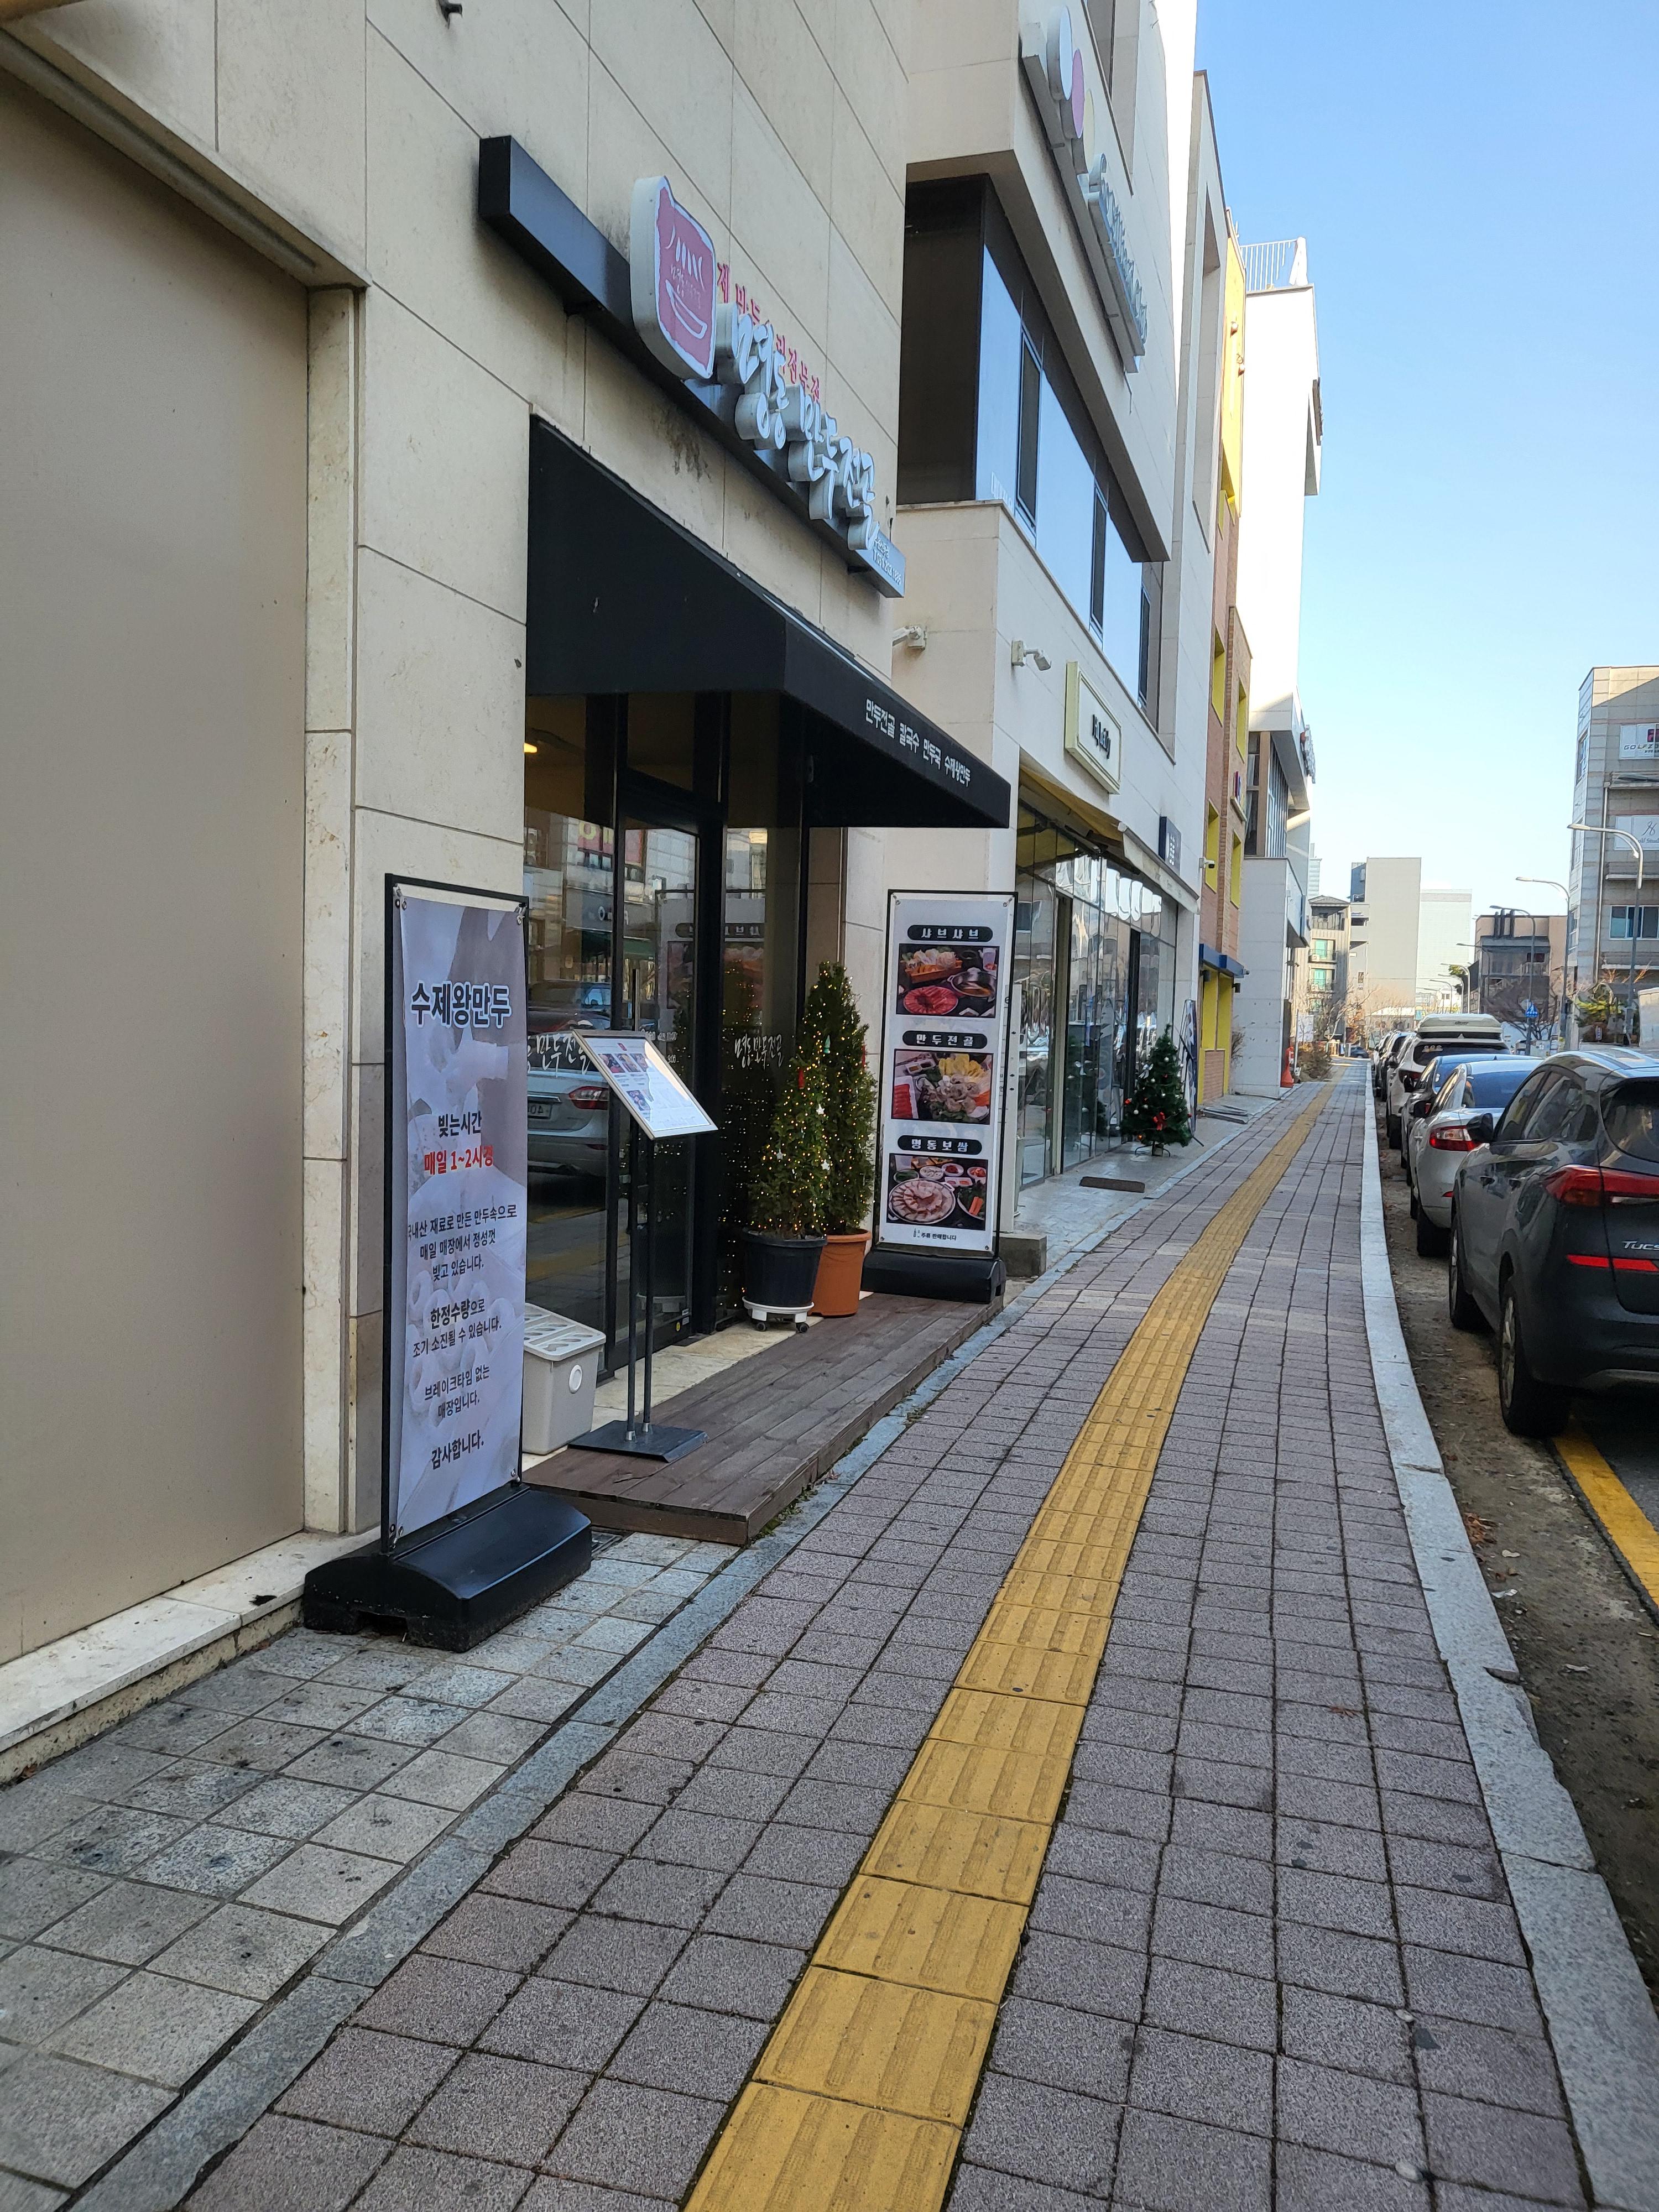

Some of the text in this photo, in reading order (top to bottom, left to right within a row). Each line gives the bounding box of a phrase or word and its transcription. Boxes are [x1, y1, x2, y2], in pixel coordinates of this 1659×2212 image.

[865, 697, 971, 787] 만두전골 칼국수 만두국 수제왕만두
[920, 928, 979, 940] 샤브샤브
[410, 981, 512, 1028] 수제왕만두
[916, 1034, 974, 1047] 만두전골
[438, 1110, 482, 1138] 빚는시간
[424, 1145, 494, 1175] 매일 1~2시경
[911, 1139, 969, 1152] 명동보쌈
[408, 1204, 518, 1241] 국내산 재료로 만든 만두속으로
[420, 1228, 496, 1260] 매일 매장에서 정성껏
[432, 1254, 484, 1282] 빚고 있습니다.
[430, 1298, 486, 1330] 한정수량으로
[413, 1315, 502, 1358] 조기 소진될 수 있습니다.
[424, 1364, 490, 1400] 브레이크타임 없는
[438, 1390, 480, 1418] 매장입니다.
[431, 1429, 484, 1470] 감사합니다.
